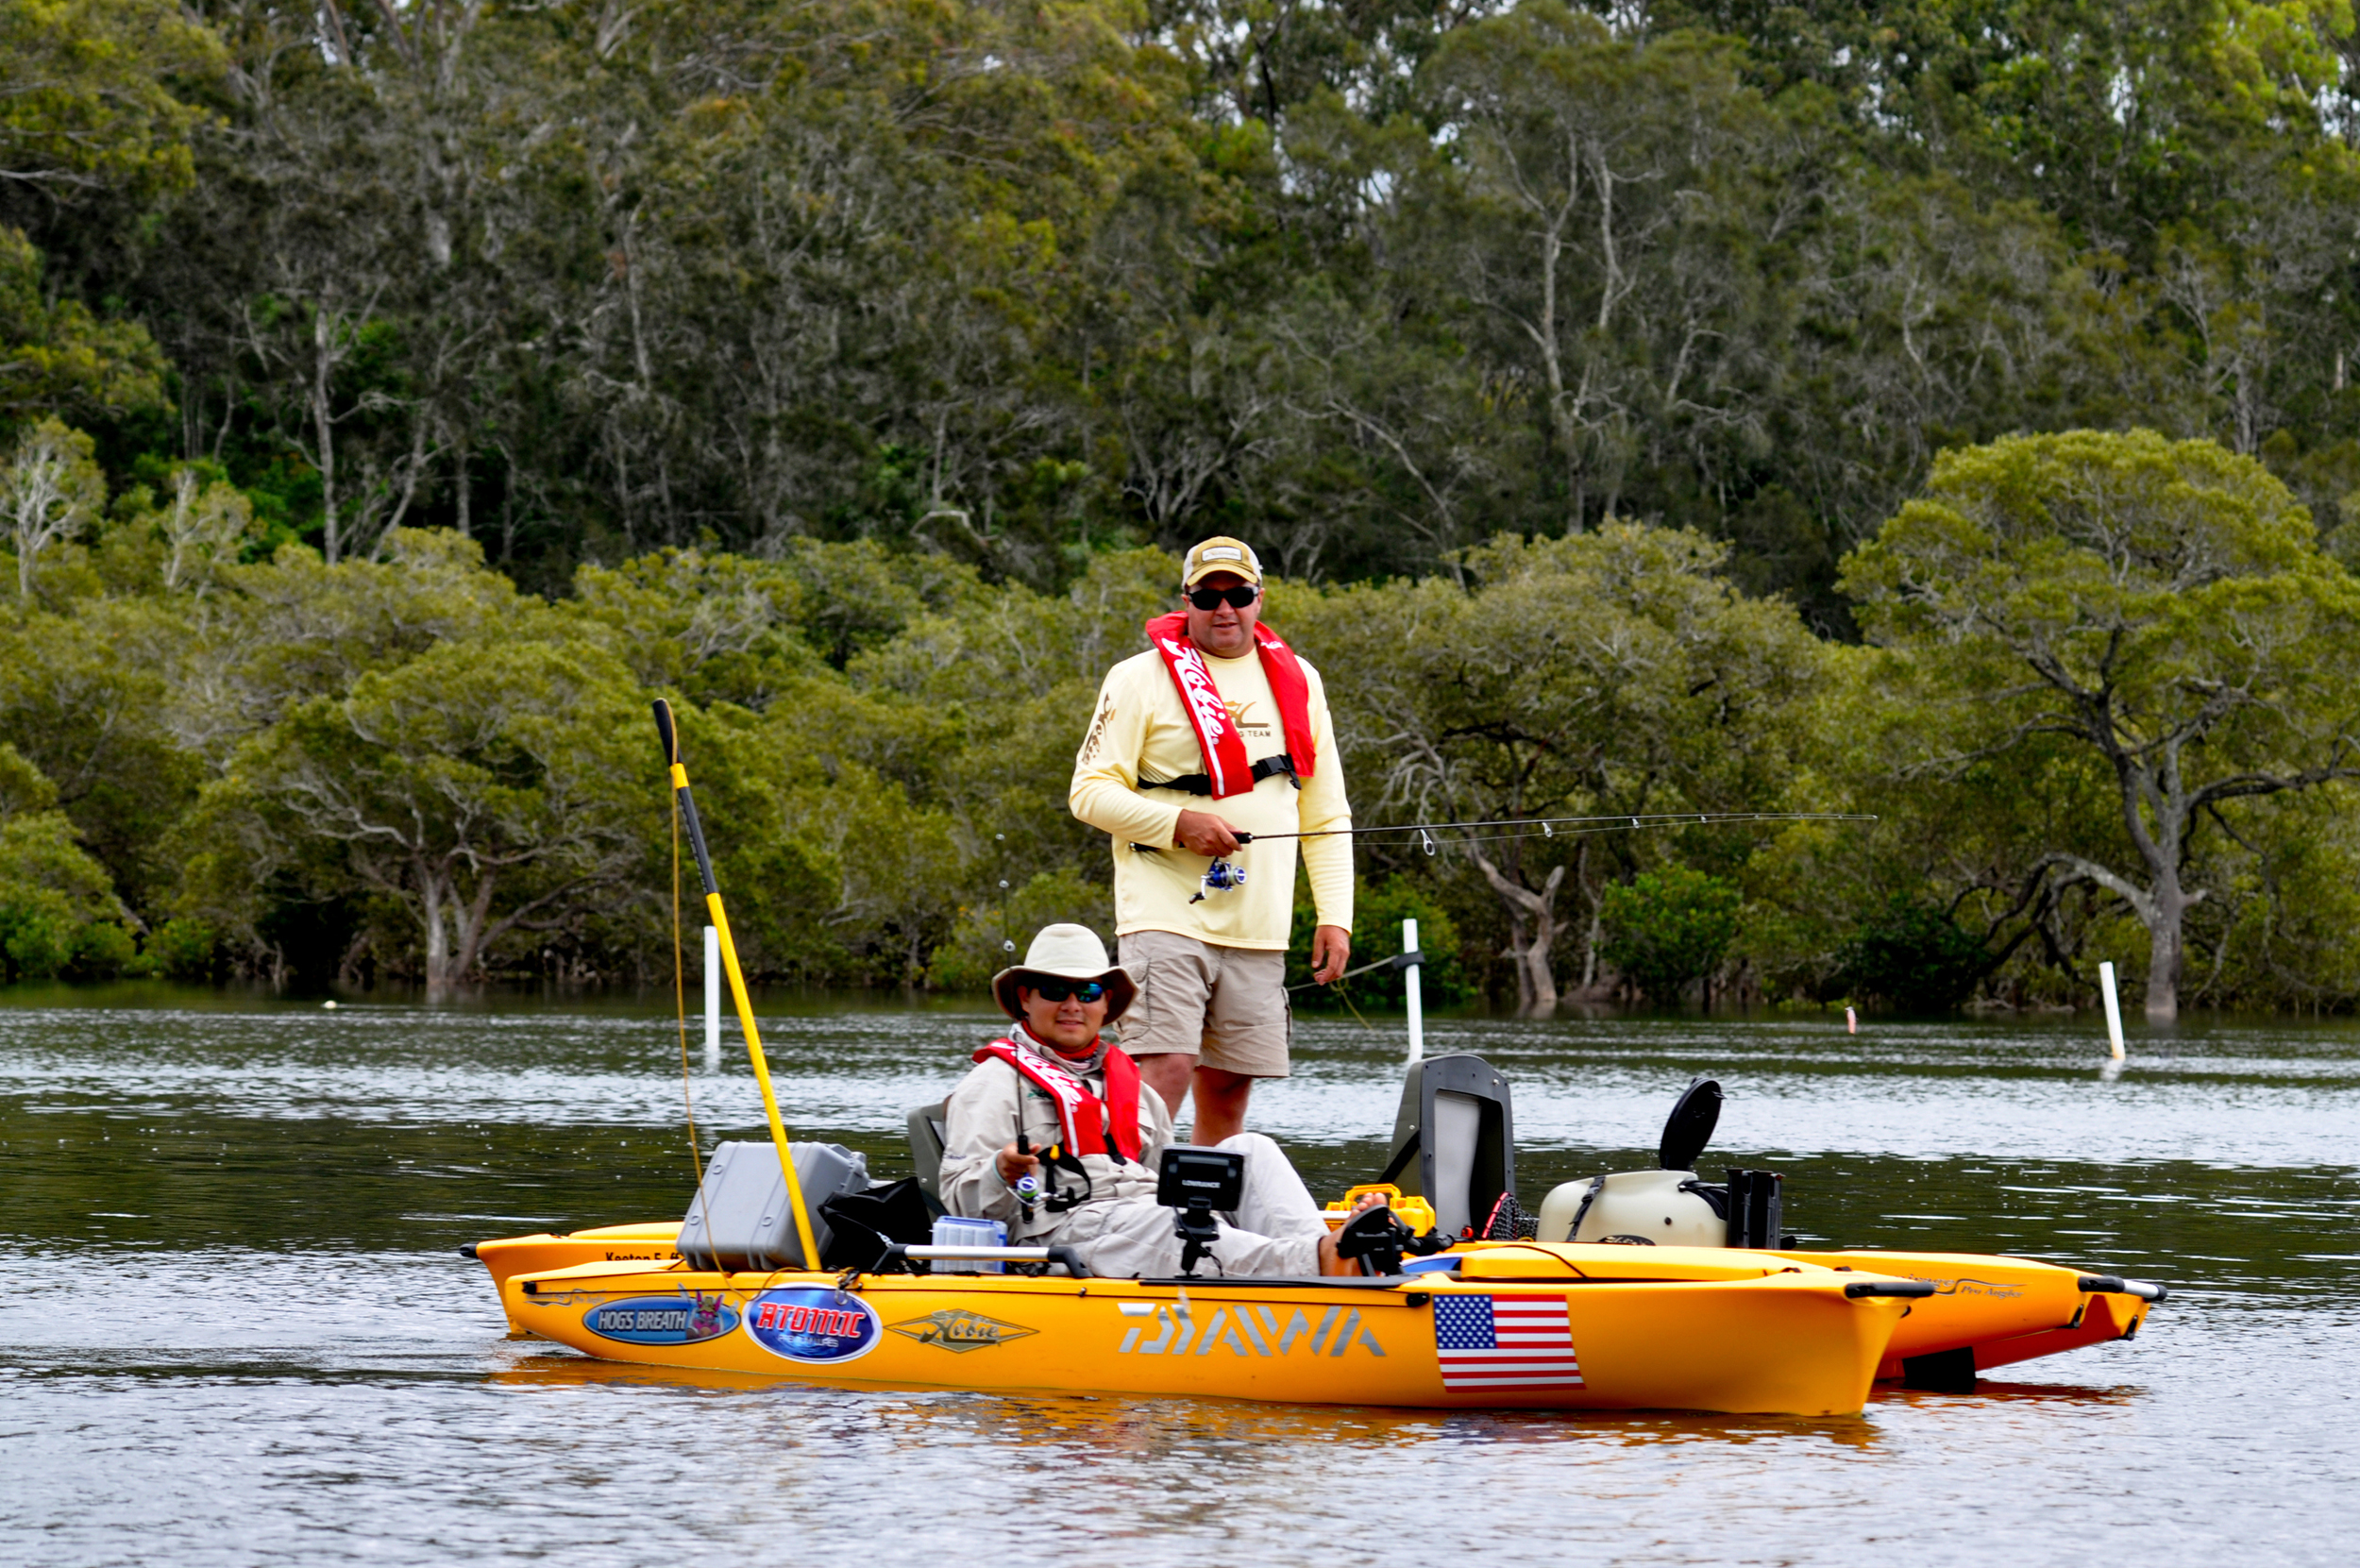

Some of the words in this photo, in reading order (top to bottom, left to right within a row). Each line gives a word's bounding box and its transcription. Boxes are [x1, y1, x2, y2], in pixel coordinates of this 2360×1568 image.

[1181, 1179, 1221, 1189] LOWRANCE
[598, 1309, 634, 1330] HOGS
[636, 1310, 688, 1331] BREATH
[756, 1302, 866, 1338] ATOMIC
[918, 1309, 1000, 1344] Hobie
[1118, 1303, 1387, 1356] DAIWA
